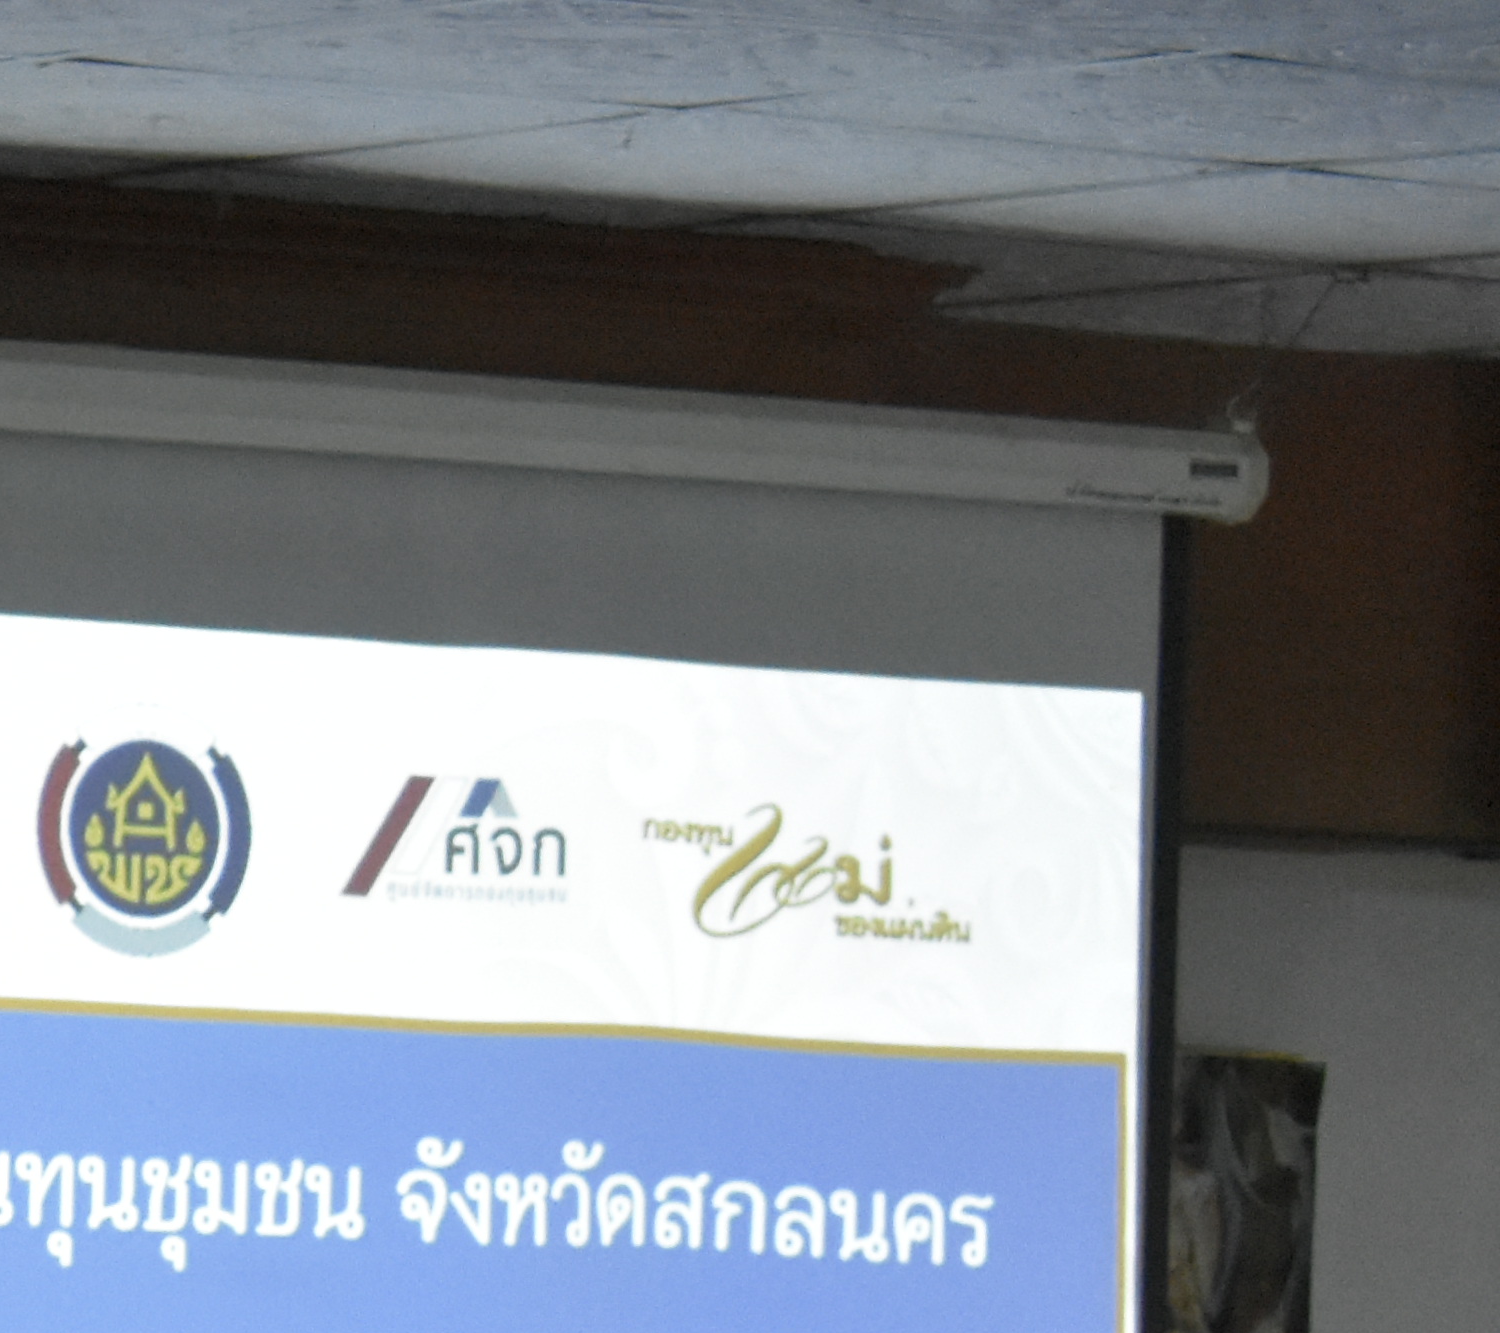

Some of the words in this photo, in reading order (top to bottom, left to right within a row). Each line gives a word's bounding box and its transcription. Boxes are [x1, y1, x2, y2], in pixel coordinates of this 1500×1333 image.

[445, 823, 566, 876] ศจก
[643, 817, 734, 856] กองทุน
[396, 1136, 996, 1269] จังหวัดสกลนคร
